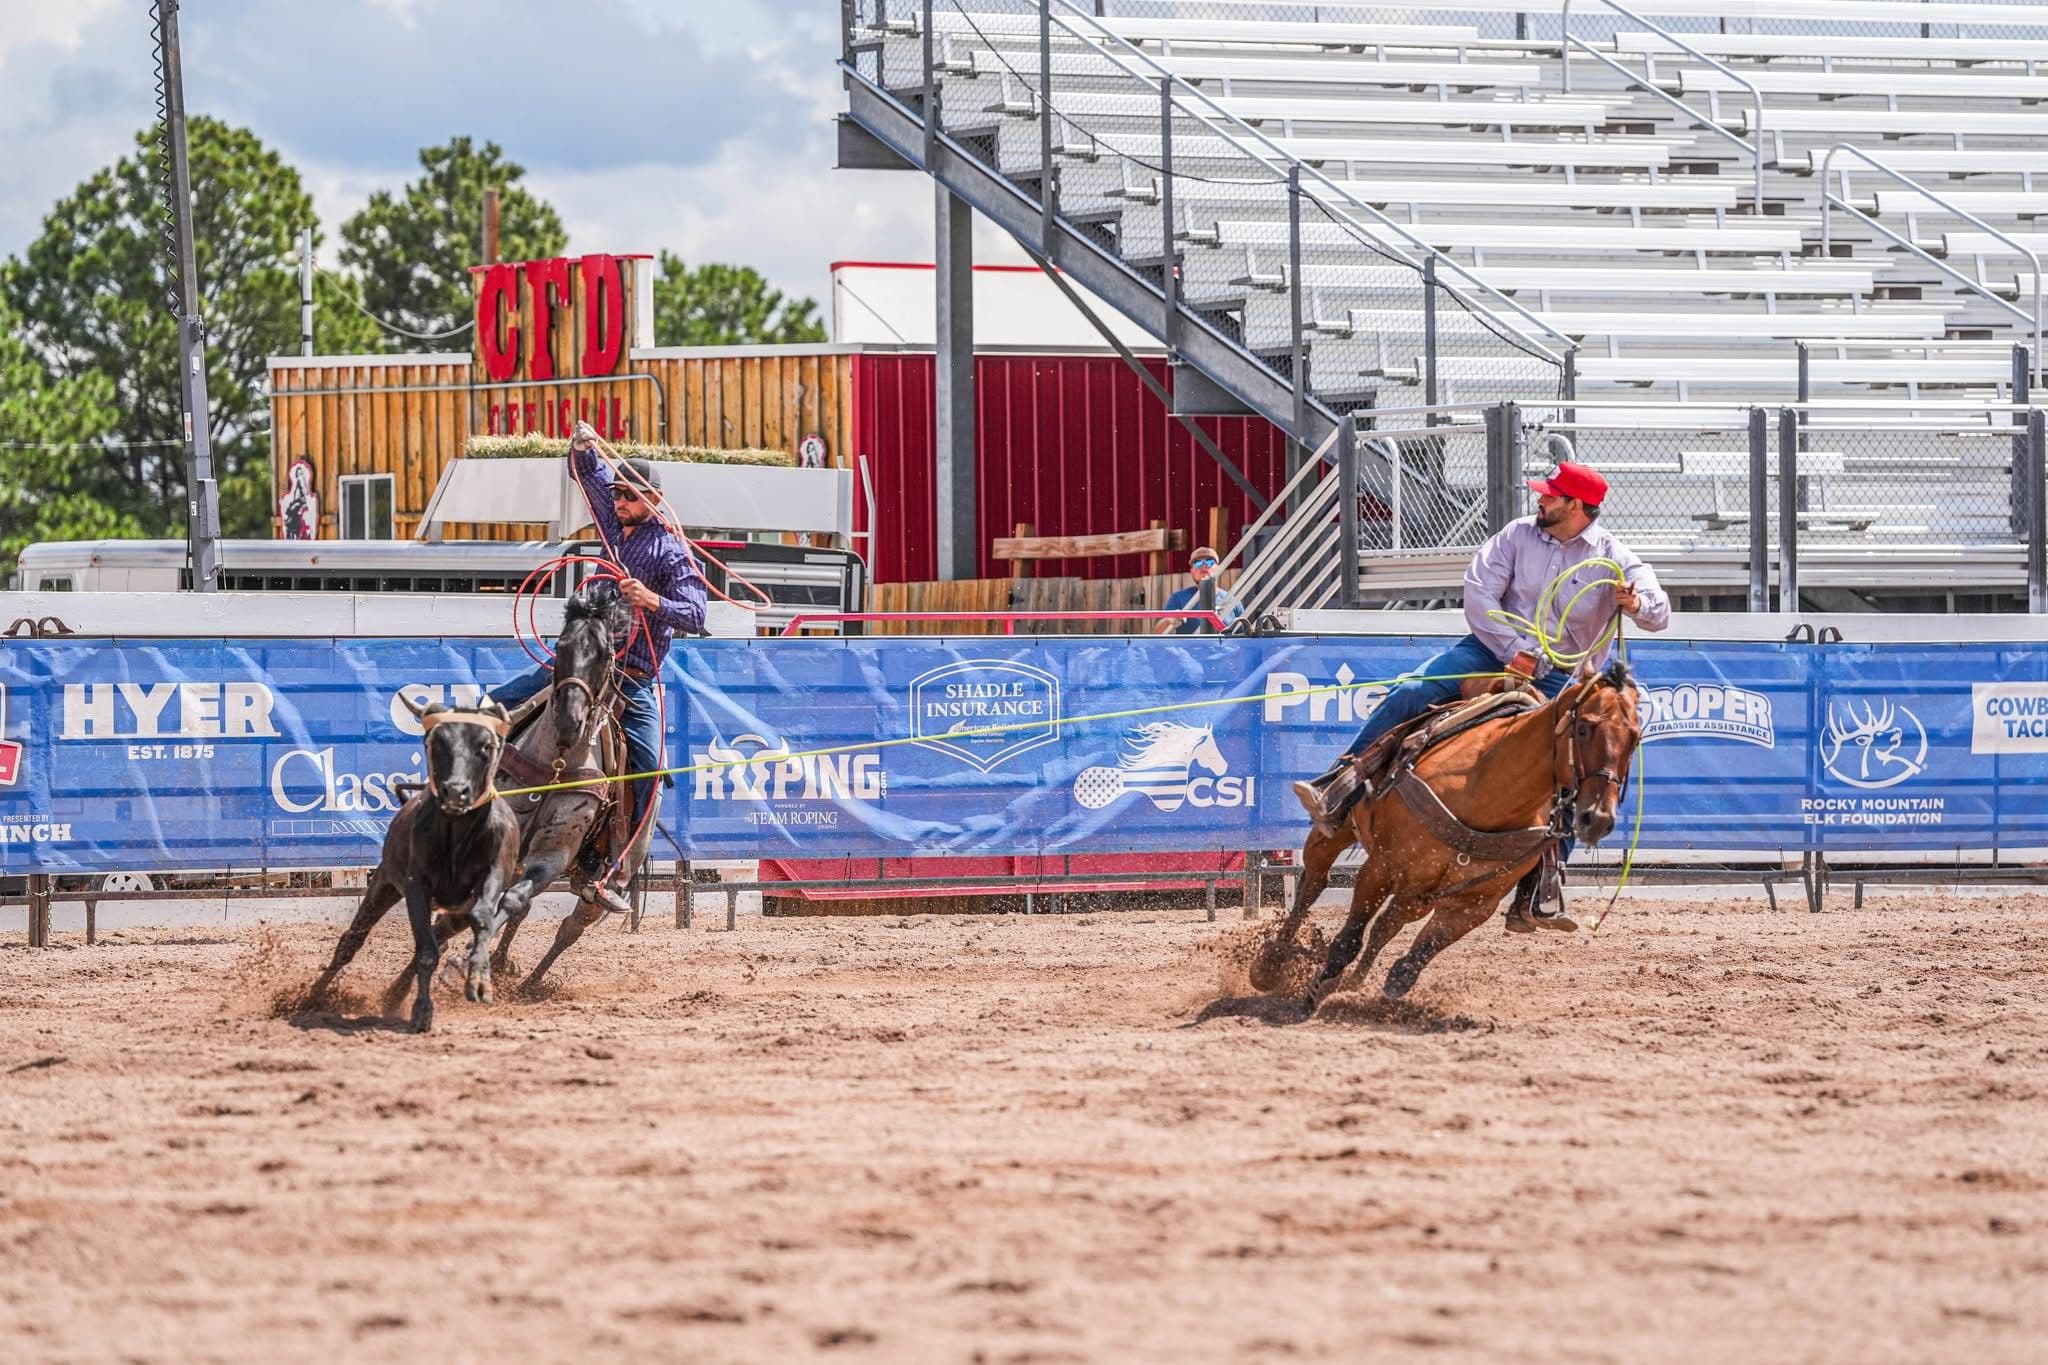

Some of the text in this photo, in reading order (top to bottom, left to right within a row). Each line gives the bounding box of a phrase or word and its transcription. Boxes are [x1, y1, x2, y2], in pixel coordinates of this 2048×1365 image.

[478, 253, 624, 381] CFD
[945, 683, 1024, 698] SHADLE
[1264, 662, 1412, 722] Prie
[60, 683, 281, 739] HYER
[926, 701, 1043, 717] INSURANCE
[1986, 697, 2048, 716] COWB
[1650, 721, 1769, 738] ROADSIDE ASSISTANCE
[128, 744, 214, 760] EST. 1875
[693, 740, 880, 800] ROPING
[271, 747, 430, 812] Classi
[1186, 776, 1256, 808] CSI
[1801, 798, 1944, 811] ROCKY MOUNTAIN
[3, 814, 40, 823] PRESENTED
[750, 811, 787, 825] TEAM
[790, 811, 837, 825] ROPING
[1803, 812, 1942, 825] ELK FOUNDATION
